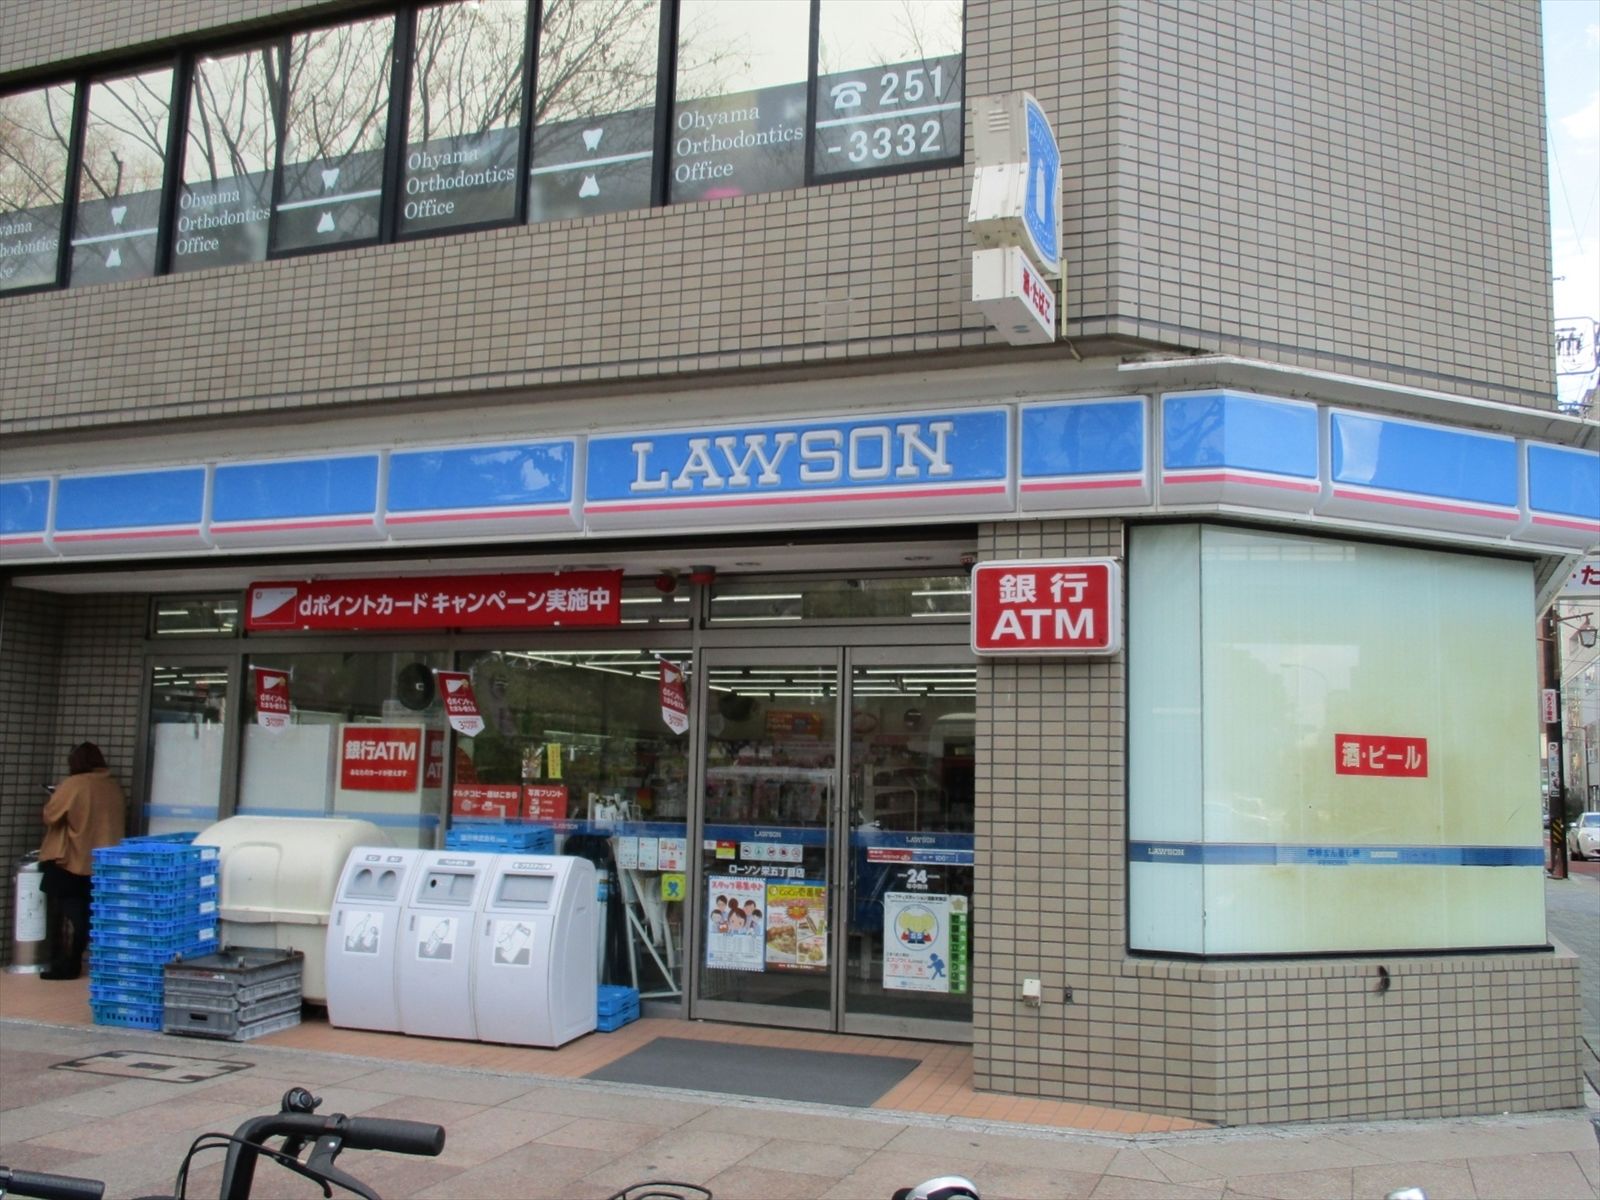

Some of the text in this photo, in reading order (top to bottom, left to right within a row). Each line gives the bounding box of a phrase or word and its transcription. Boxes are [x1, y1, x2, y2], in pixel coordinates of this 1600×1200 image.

[879, 65, 942, 105] 251
[678, 106, 760, 131] Ohyama
[676, 124, 804, 157] Orthodontics
[408, 149, 479, 174] Ohyama
[675, 161, 733, 183] Office
[406, 166, 515, 195] Orthodontics
[180, 188, 240, 211] Ohyama
[404, 199, 455, 220] Office
[178, 205, 271, 233] Orthodontics
[176, 237, 219, 256] Office
[629, 420, 954, 493] LAWSON
[998, 572, 1088, 604] 銀行
[990, 608, 1095, 641] ATM
[345, 740, 416, 761] 銀行ATM
[1342, 741, 1421, 770] 酒・ビール
[754, 830, 782, 838] LAWSON
[906, 836, 935, 844] LAWSON
[1148, 847, 1184, 856] LAWSON
[907, 868, 928, 884] 24
